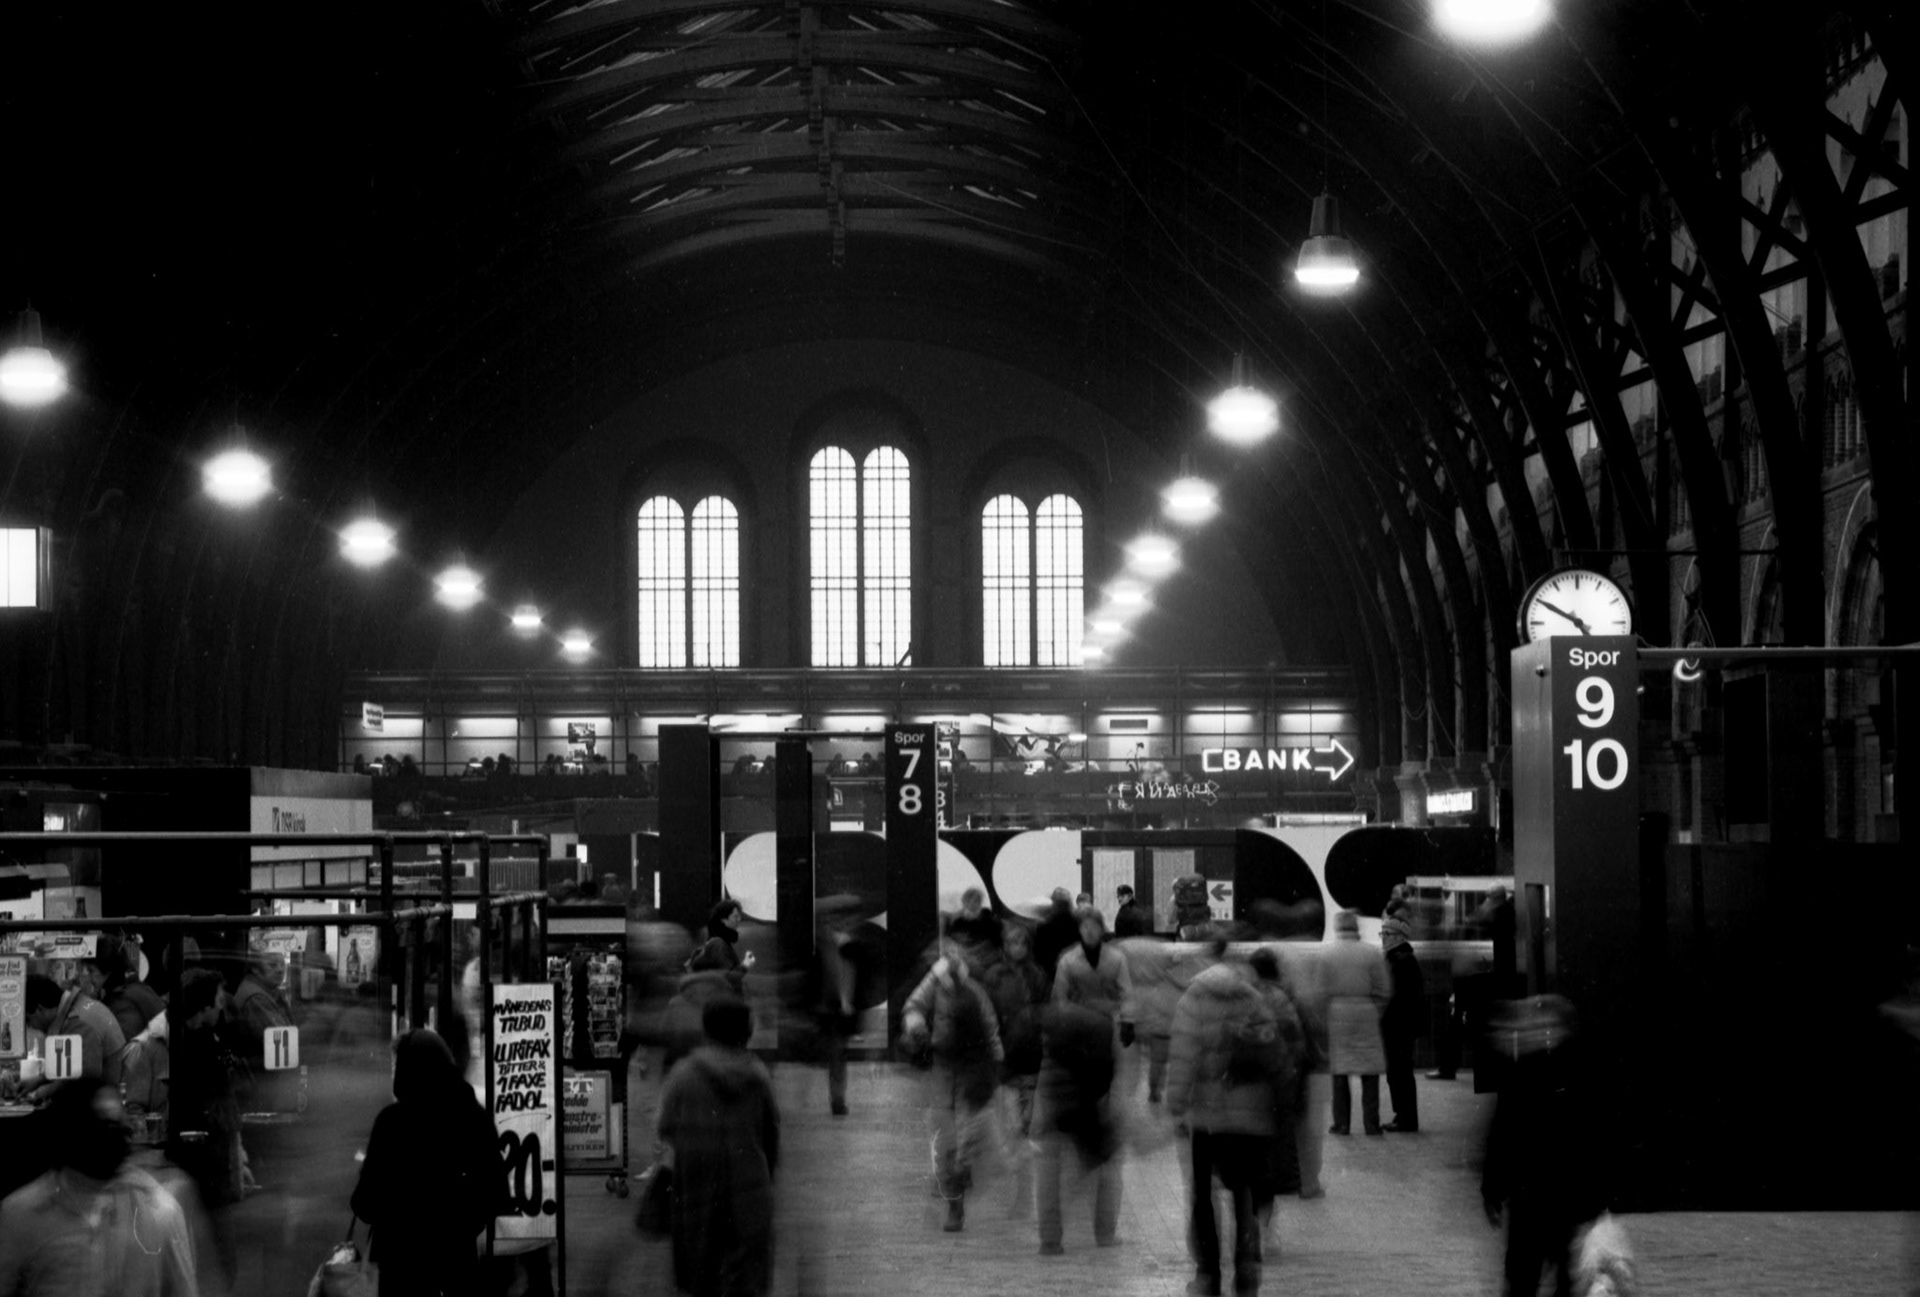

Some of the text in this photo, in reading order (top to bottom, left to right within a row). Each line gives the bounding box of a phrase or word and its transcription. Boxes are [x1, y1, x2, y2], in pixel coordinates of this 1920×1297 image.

[1568, 646, 1621, 669] Spor
[1574, 675, 1615, 728] 9
[894, 731, 926, 746] Spor
[899, 748, 921, 779] 7
[1223, 748, 1313, 771] BANK
[1562, 738, 1629, 790] 10
[898, 783, 923, 815] 8
